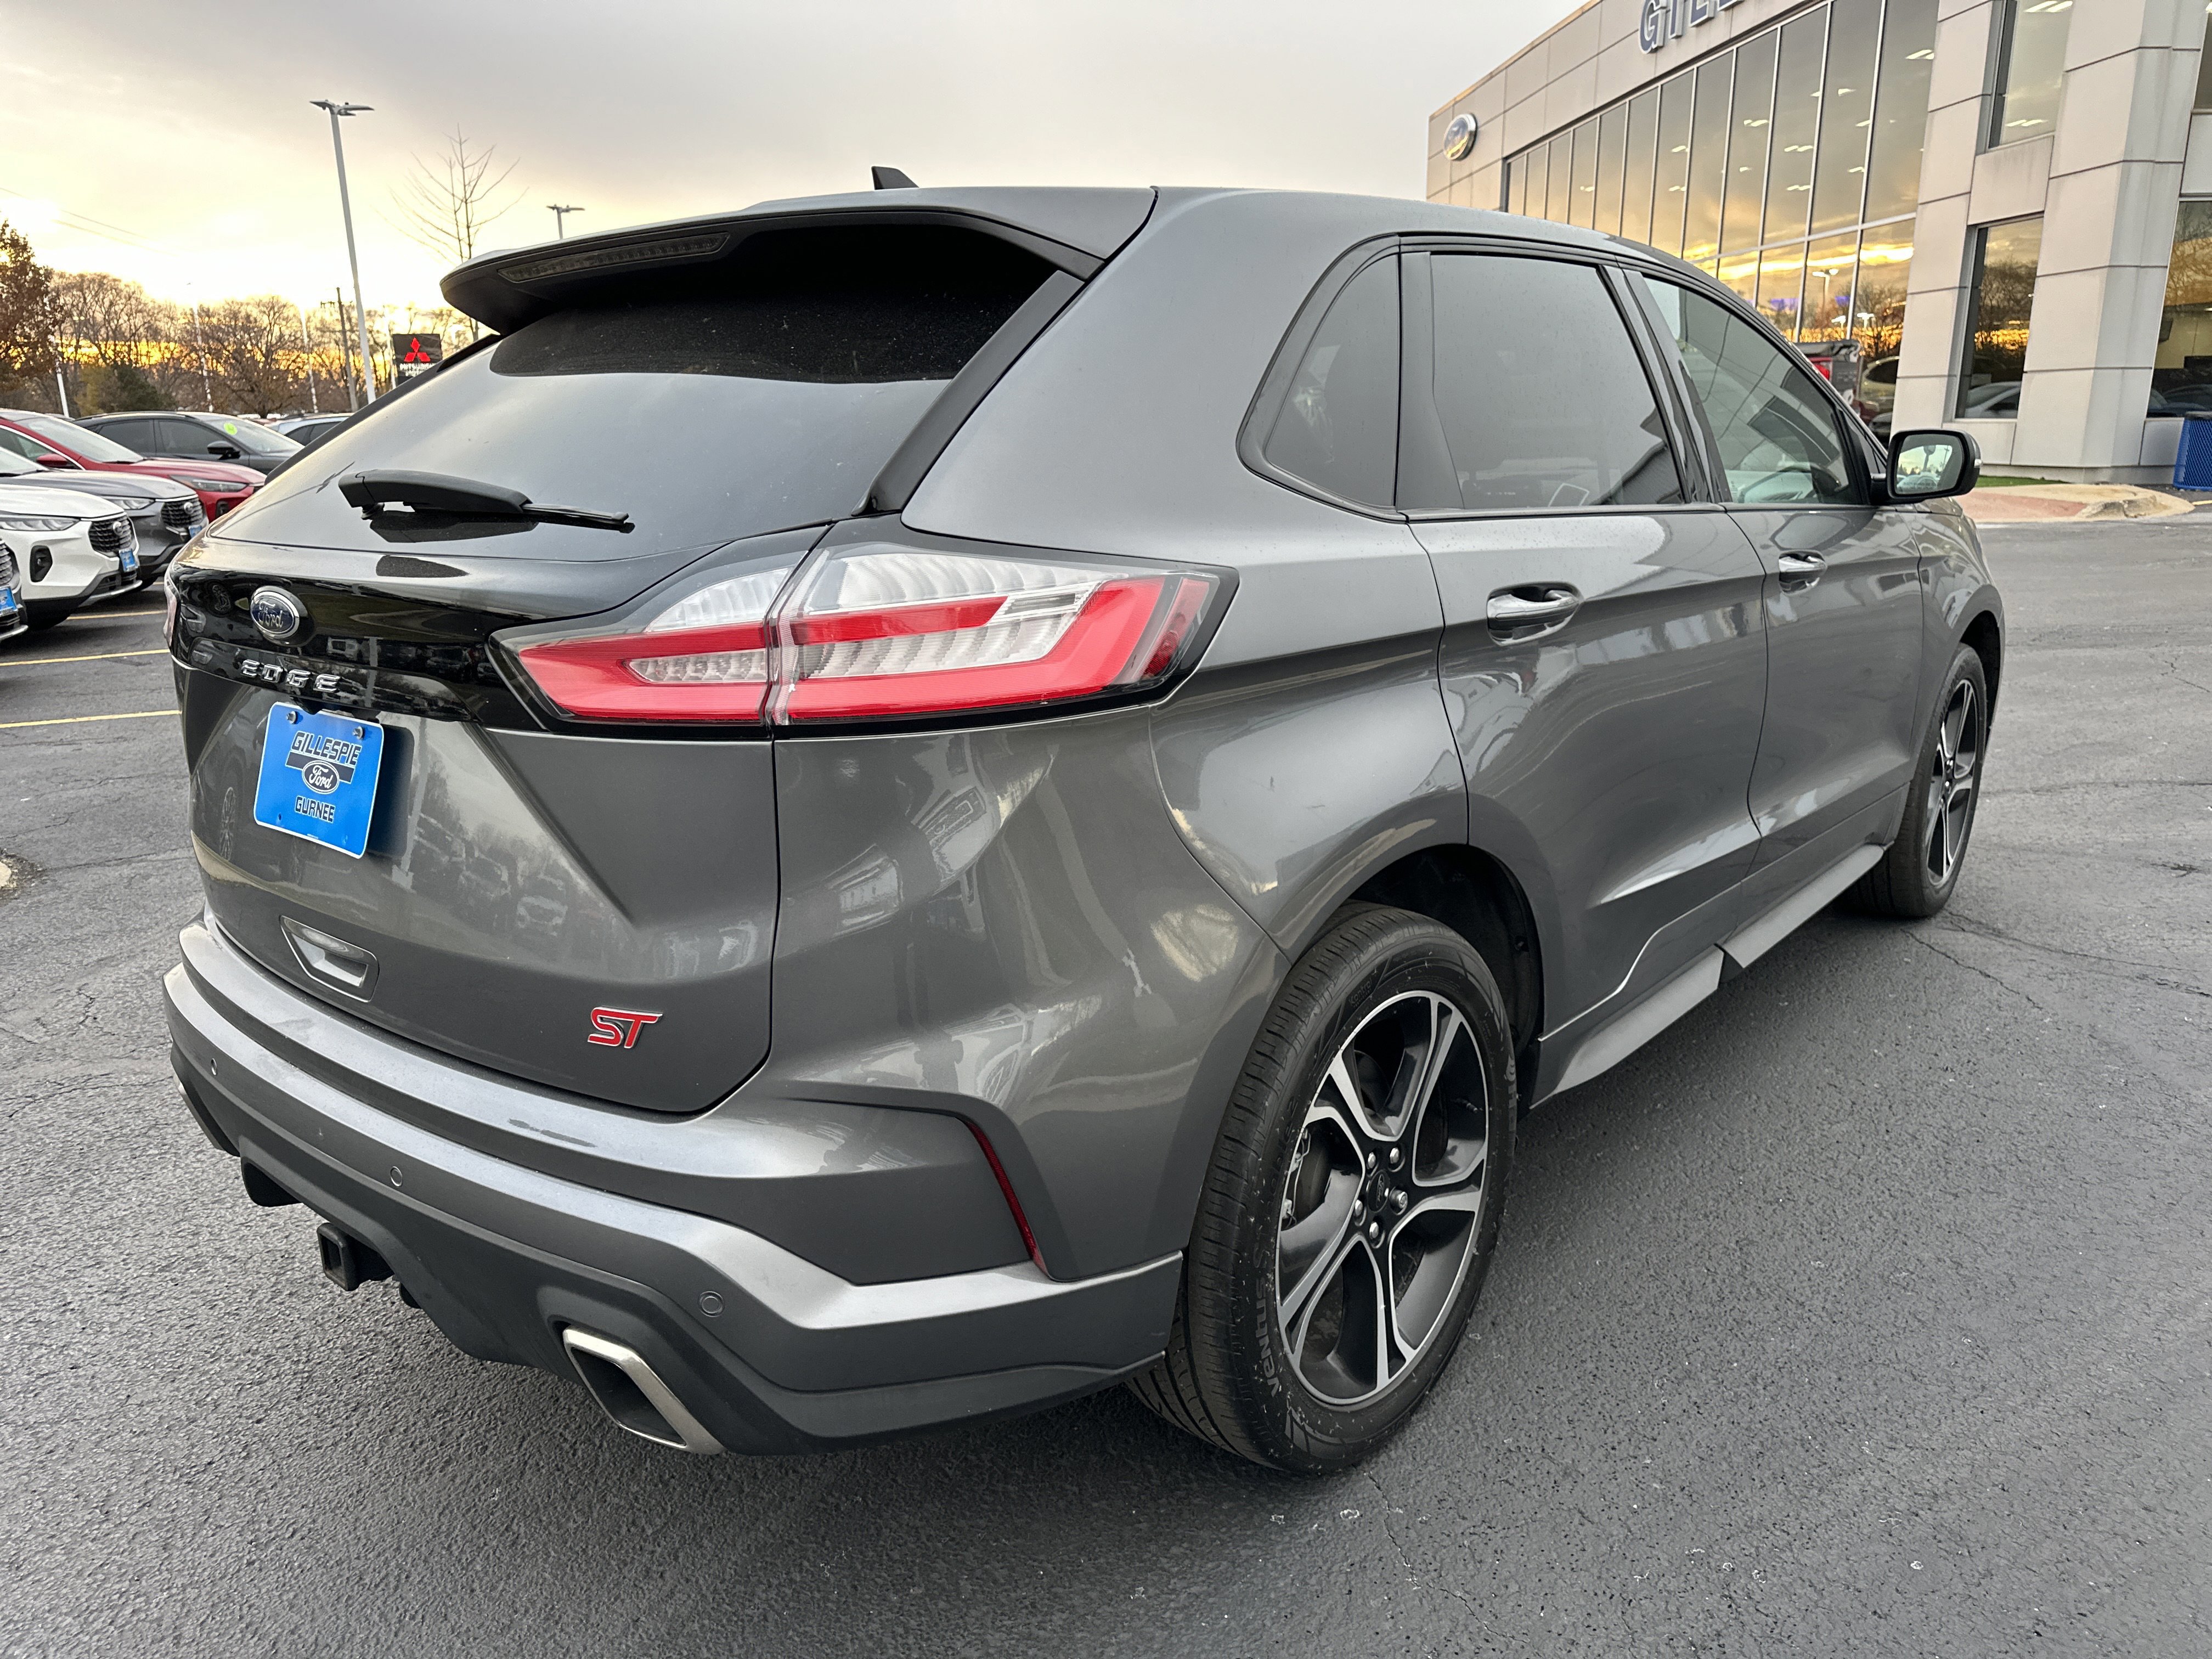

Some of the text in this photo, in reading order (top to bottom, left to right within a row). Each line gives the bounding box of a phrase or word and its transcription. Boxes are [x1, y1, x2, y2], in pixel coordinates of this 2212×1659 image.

[258, 601, 284, 628] Ford
[241, 659, 341, 692] EDGE
[291, 730, 363, 766] GILLESPIE
[308, 765, 334, 789] Ford
[295, 795, 336, 823] GURNEE
[587, 1006, 663, 1048] ST
